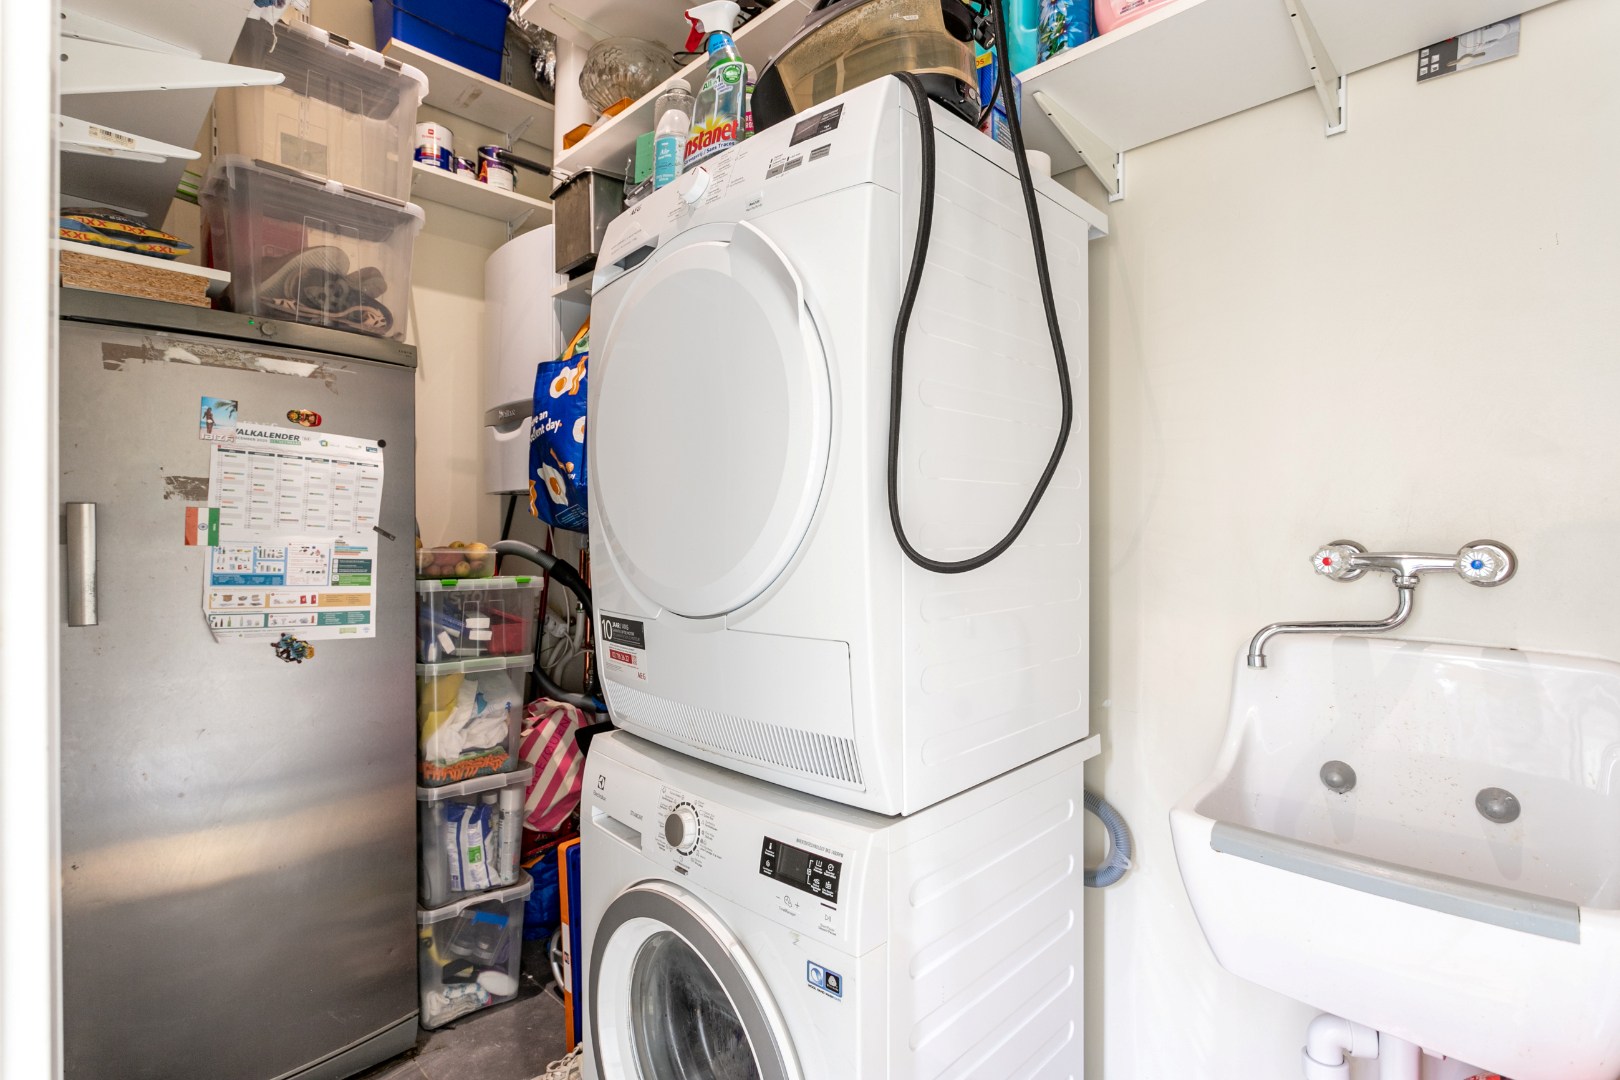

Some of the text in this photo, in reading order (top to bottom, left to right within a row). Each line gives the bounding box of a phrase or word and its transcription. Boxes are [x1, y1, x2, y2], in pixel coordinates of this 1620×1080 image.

[147, 244, 176, 254] XXL
[201, 433, 235, 443] IBIZA
[601, 619, 613, 640] 10
